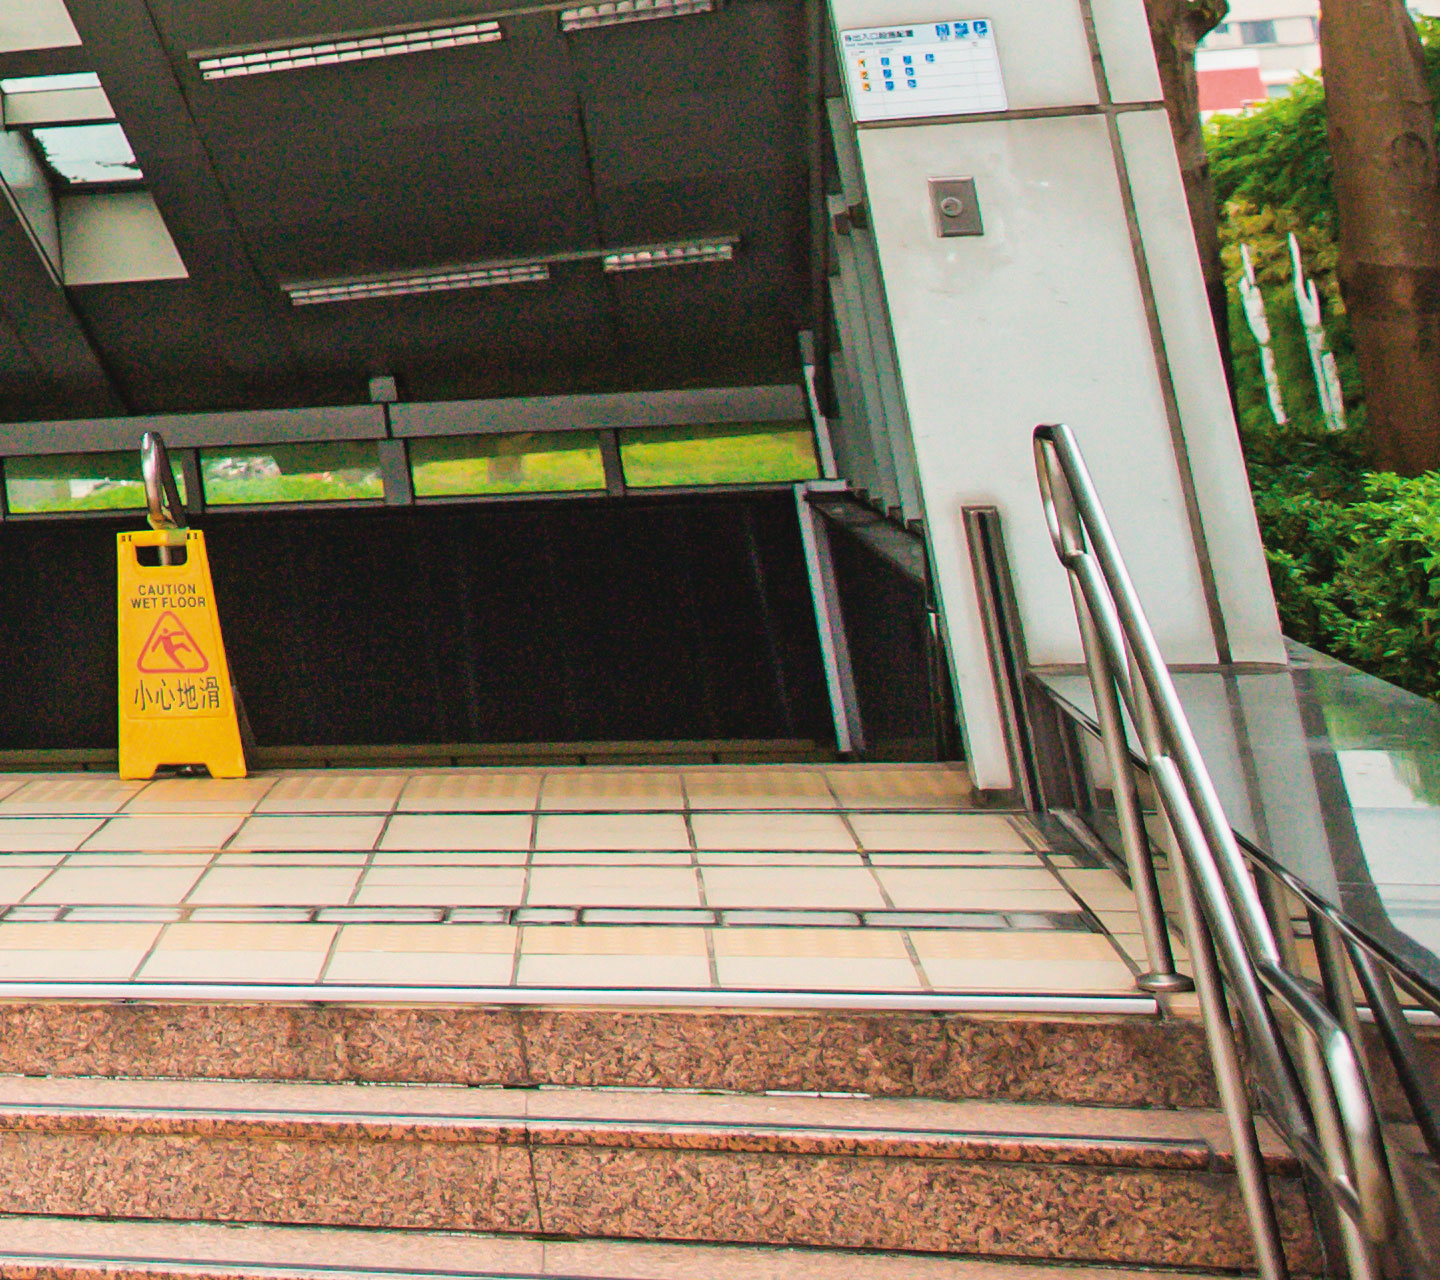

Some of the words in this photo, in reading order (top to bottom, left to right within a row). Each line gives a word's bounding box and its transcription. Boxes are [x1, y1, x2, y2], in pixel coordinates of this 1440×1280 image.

[138, 584, 196, 596] CAUTION
[131, 598, 158, 609] WET
[162, 597, 206, 608] FLOOR
[134, 677, 220, 711] 小心地滑
